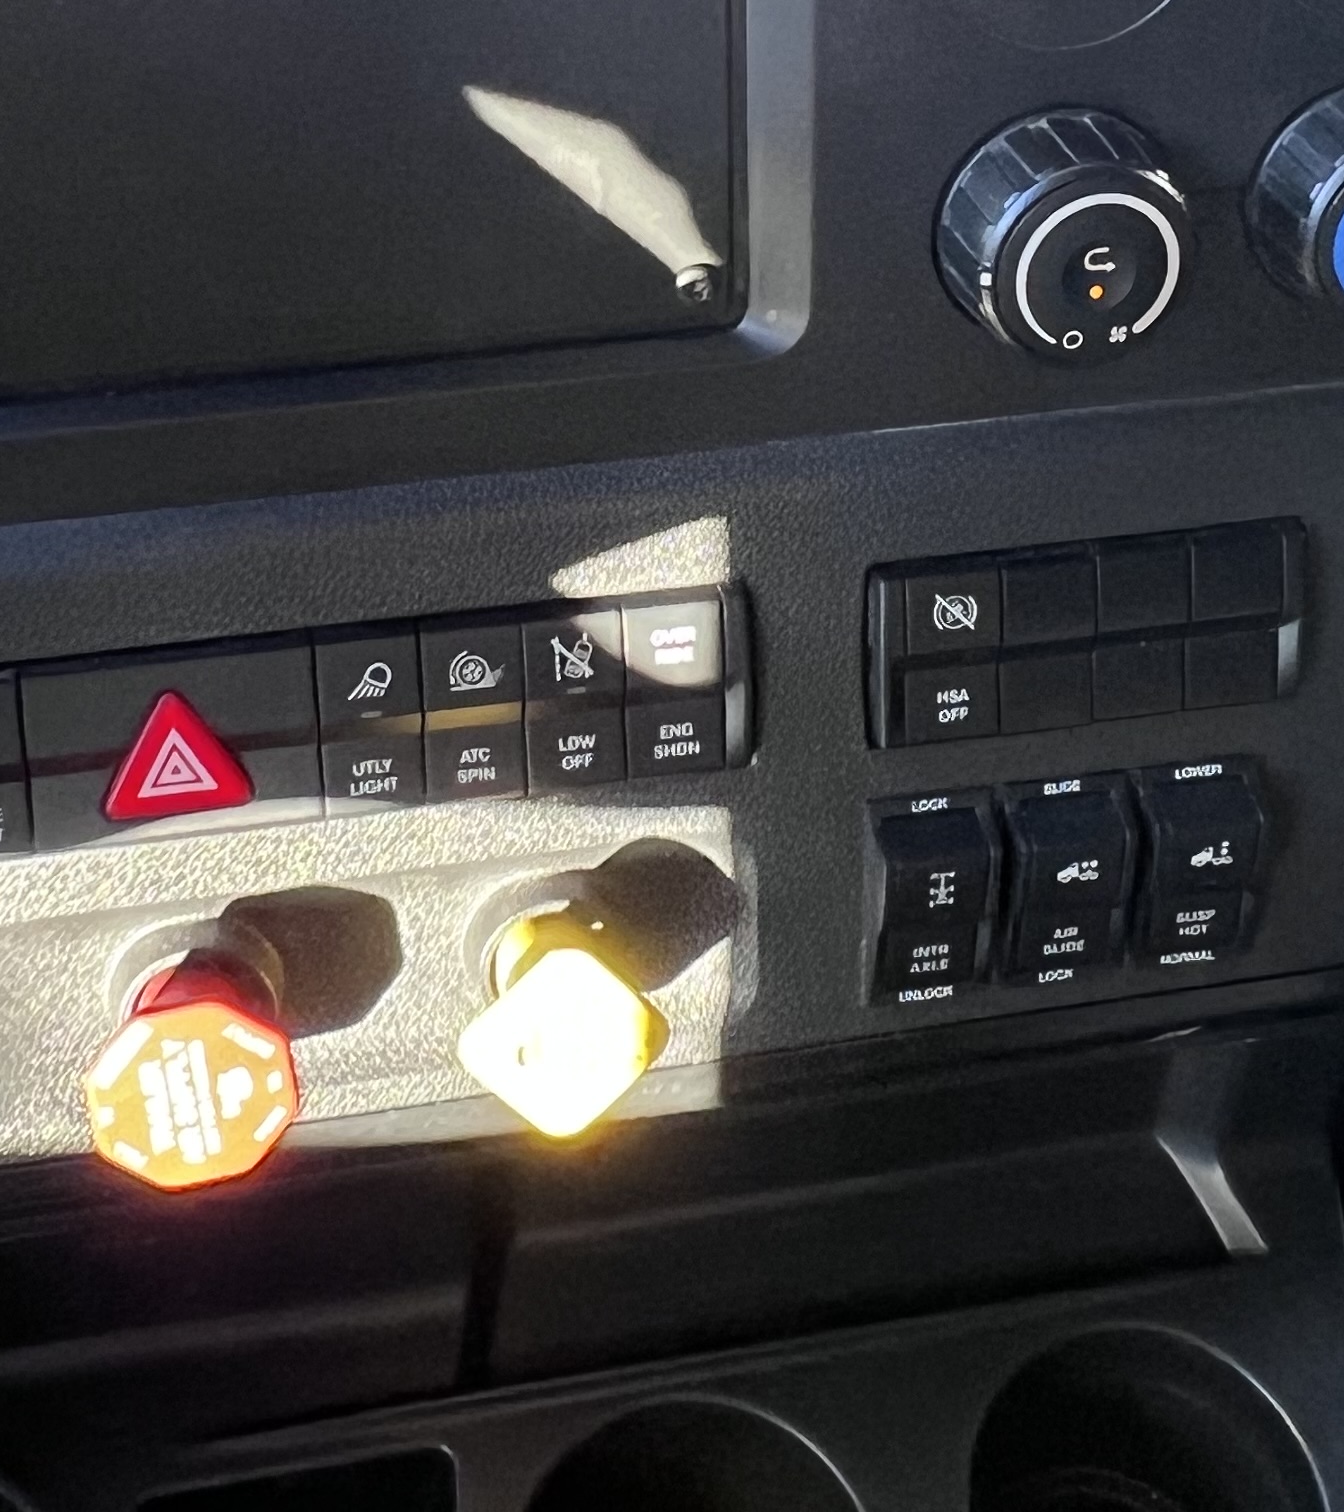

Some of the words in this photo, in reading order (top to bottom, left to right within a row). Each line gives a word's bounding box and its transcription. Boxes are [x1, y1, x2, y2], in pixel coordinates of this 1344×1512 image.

[459, 747, 491, 765] ATC
[561, 751, 595, 771] OFF
[350, 776, 398, 797] LIGHT
[911, 796, 949, 813] LOCK
